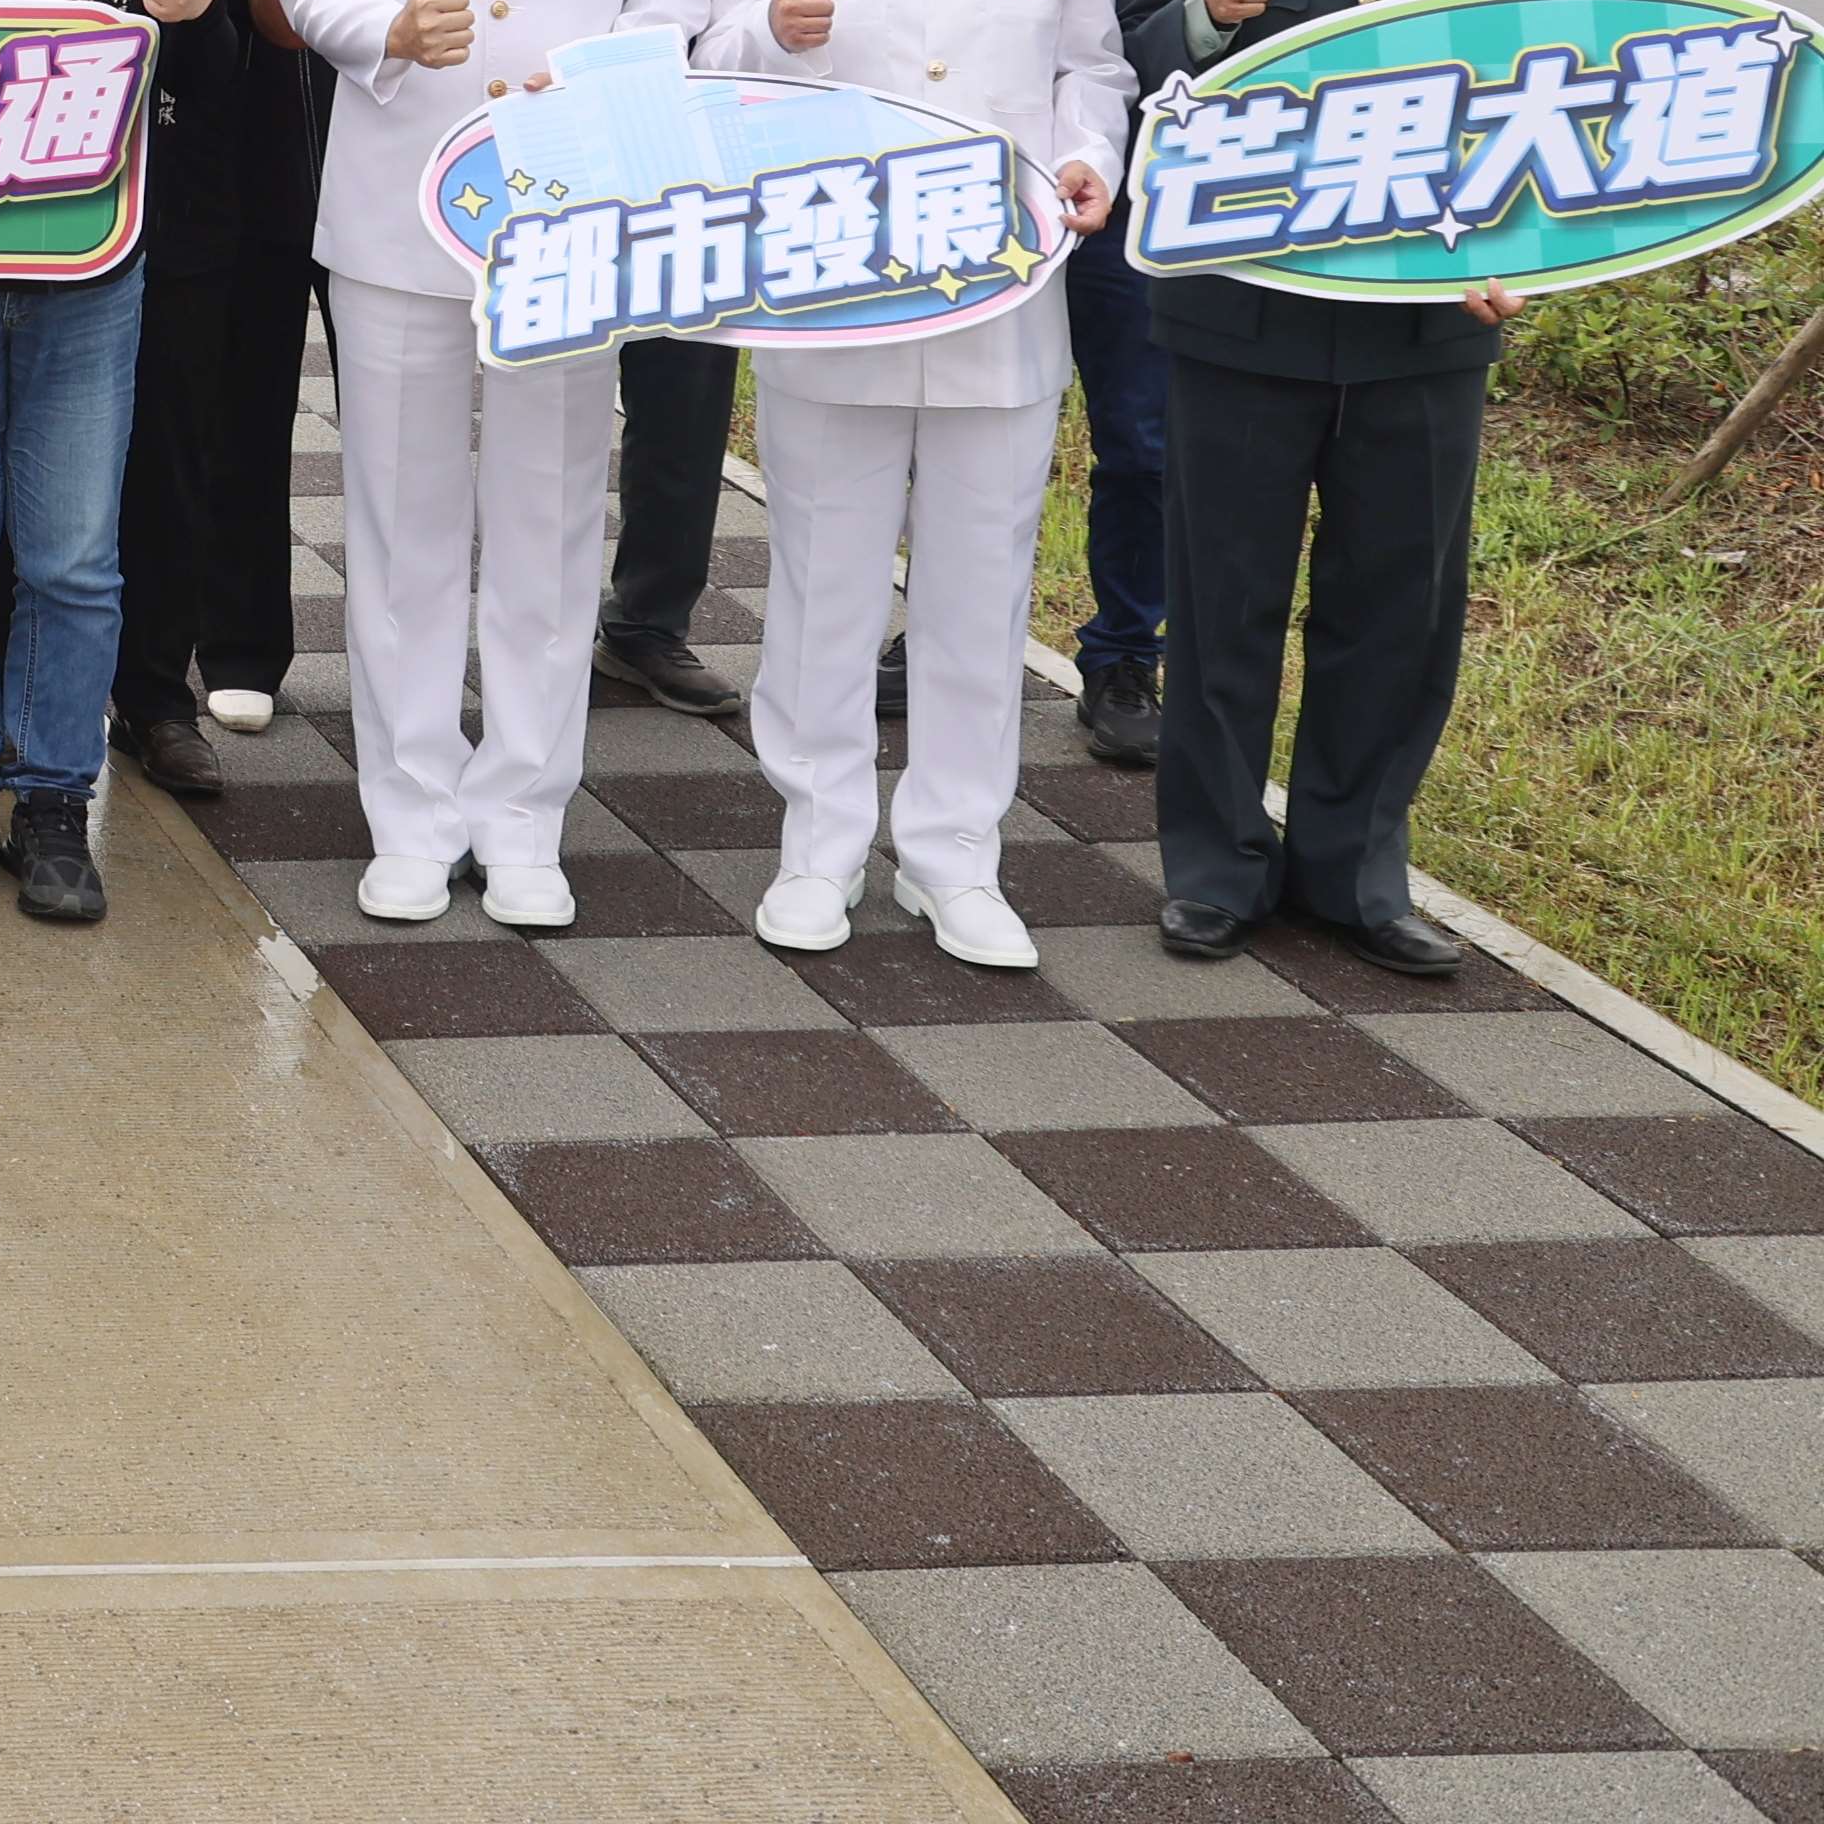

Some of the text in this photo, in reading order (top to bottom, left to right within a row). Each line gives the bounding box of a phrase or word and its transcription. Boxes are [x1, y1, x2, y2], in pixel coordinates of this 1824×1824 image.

[495, 142, 1016, 352] 都市發展
[1147, 28, 1782, 252] 芒果大道
